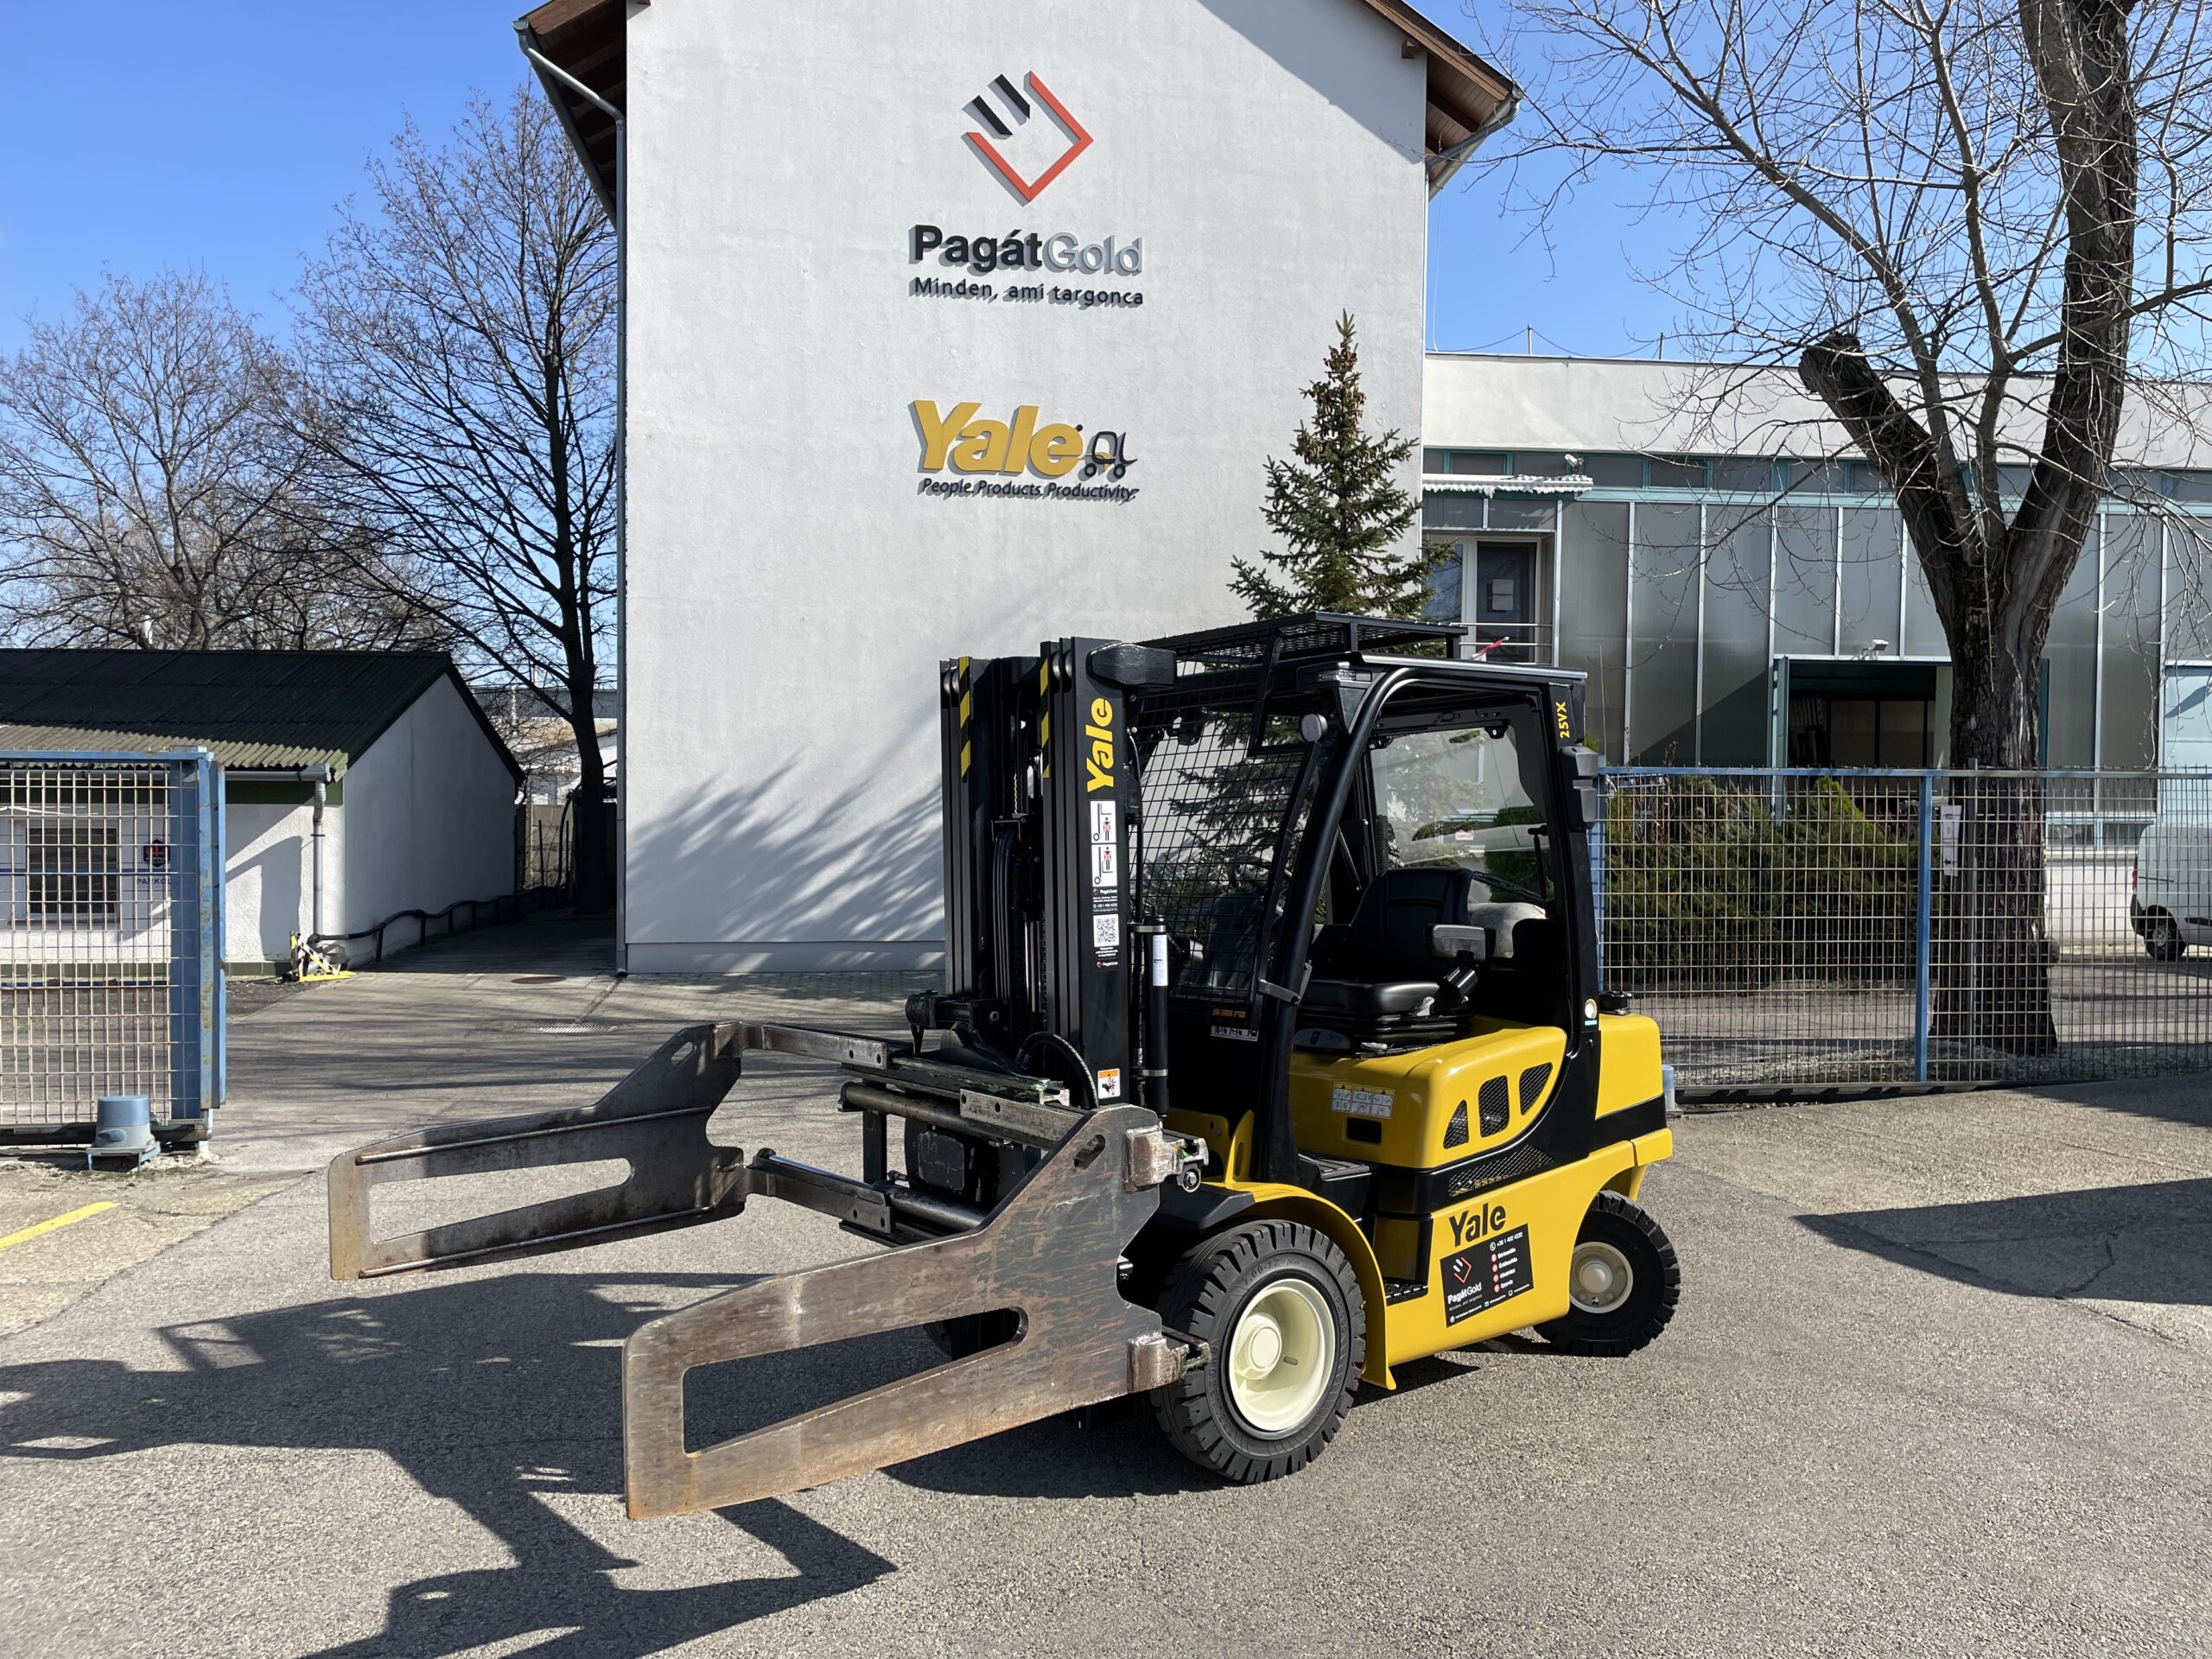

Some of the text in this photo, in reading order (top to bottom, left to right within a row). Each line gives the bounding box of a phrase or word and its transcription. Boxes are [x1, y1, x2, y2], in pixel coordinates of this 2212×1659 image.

[915, 225, 1143, 272] PagátGold
[914, 277, 1144, 306] Minden, ami targonca
[913, 400, 1084, 476] Yale
[922, 478, 975, 497] People.
[977, 480, 1043, 496] Products.
[1555, 702, 1570, 739] 25VX
[1085, 697, 1115, 792] Yale
[1448, 1203, 1507, 1248] Yale
[1447, 1281, 1483, 1305] PagátGold
